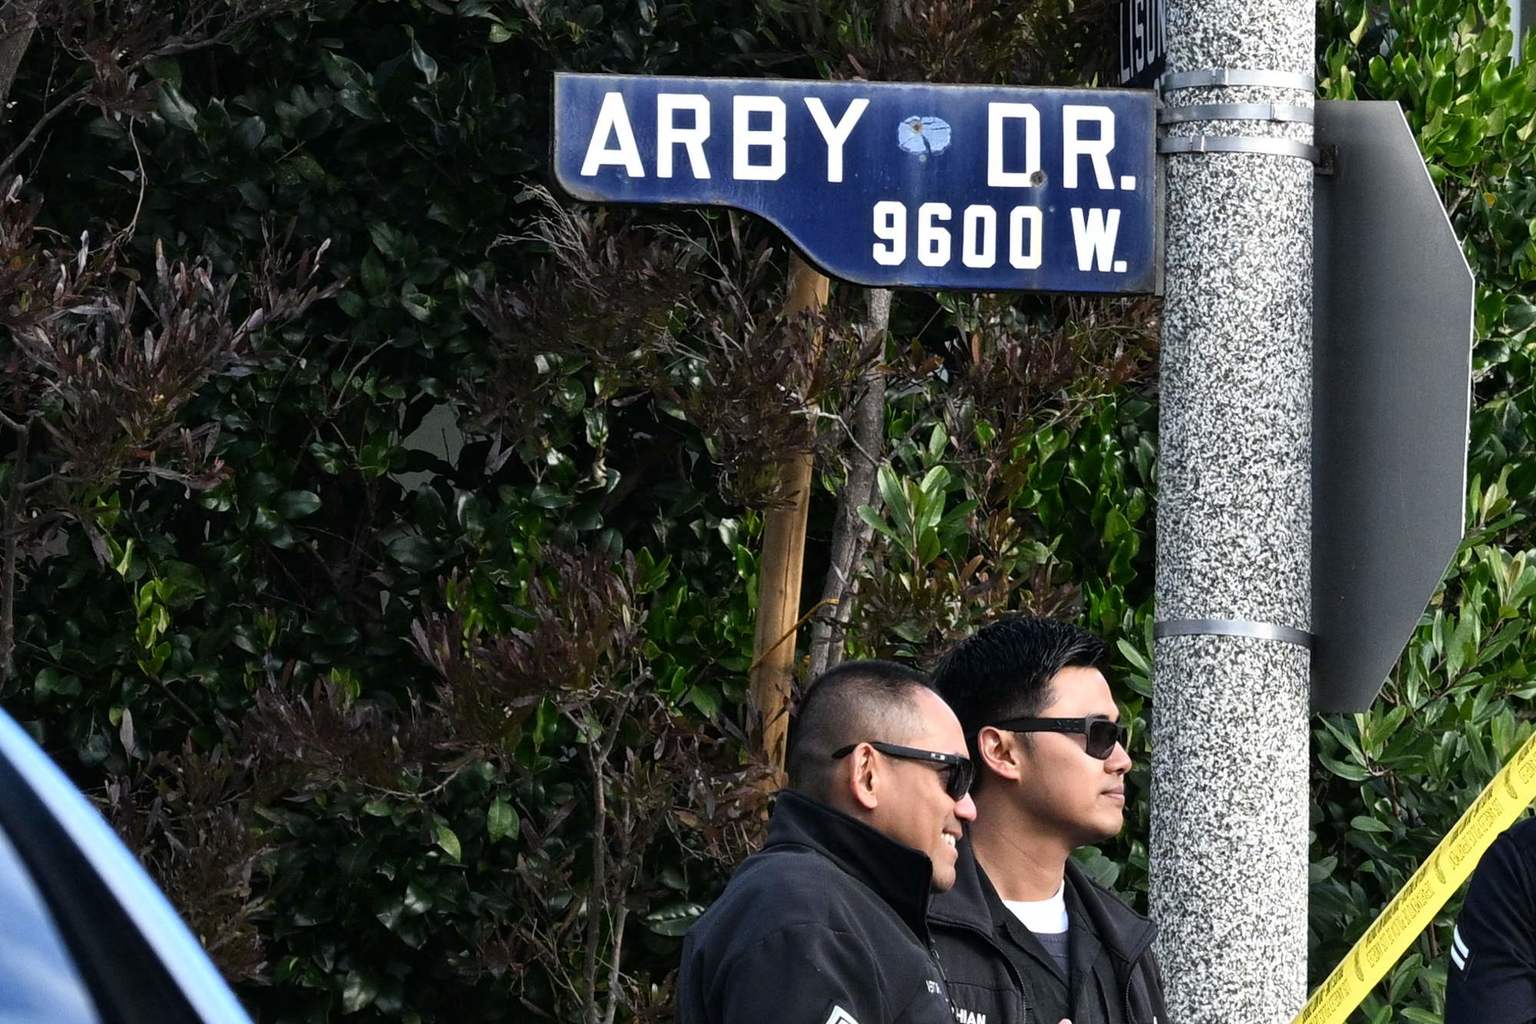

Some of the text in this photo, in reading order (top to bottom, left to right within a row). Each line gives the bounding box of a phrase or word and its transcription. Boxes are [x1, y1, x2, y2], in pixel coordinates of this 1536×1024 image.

[580, 91, 1136, 191] ARBY DR.
[872, 200, 1128, 272] 9600 W.
